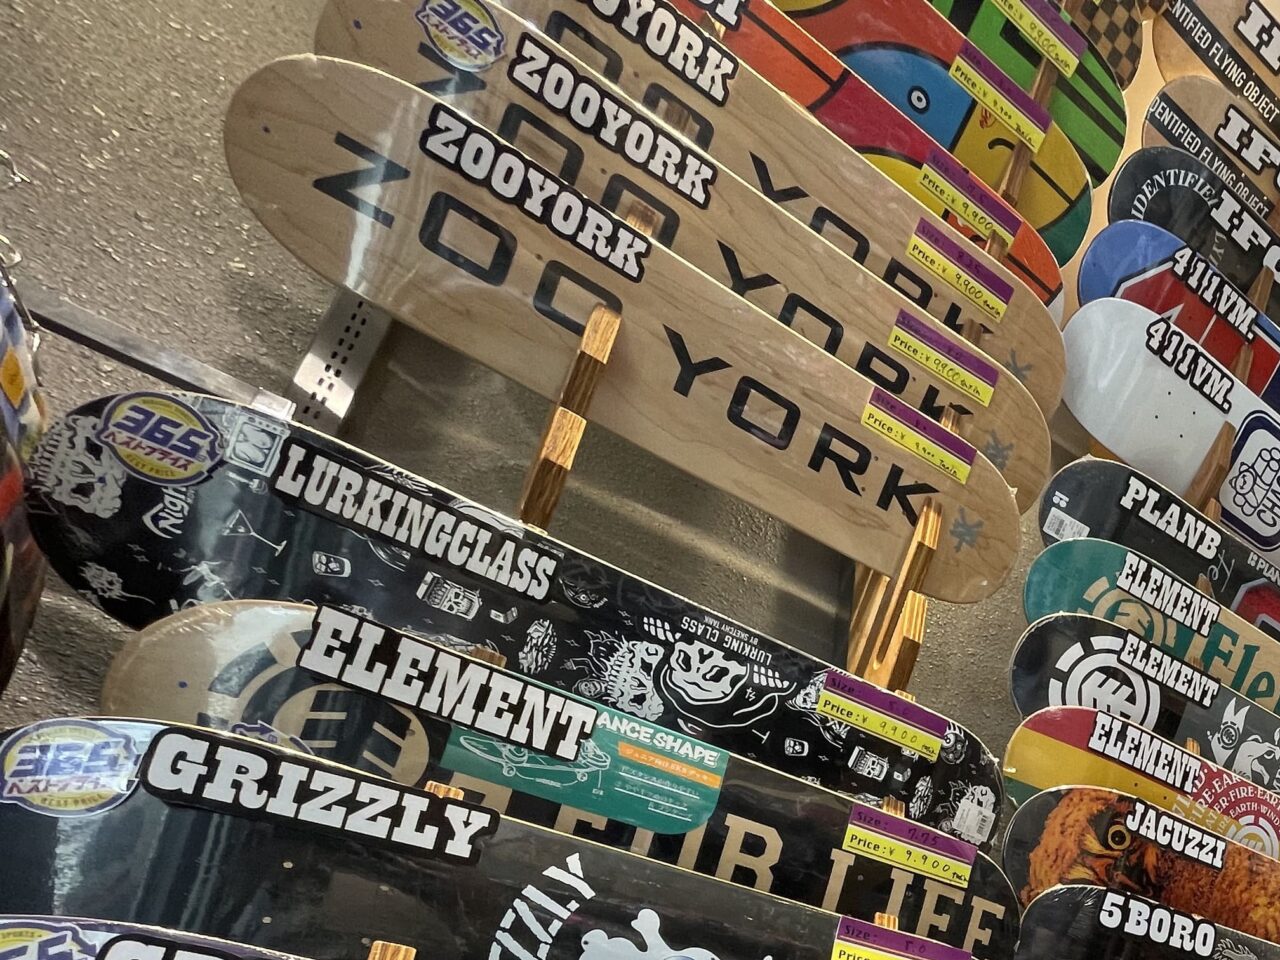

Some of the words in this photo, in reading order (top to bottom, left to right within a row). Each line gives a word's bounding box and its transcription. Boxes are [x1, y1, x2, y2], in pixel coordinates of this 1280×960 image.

[590, 0, 735, 103] YORK
[1208, 41, 1247, 88] FLYING
[1242, 80, 1280, 123] OBJECT
[512, 37, 713, 205] ZOOYORK
[425, 111, 648, 279] ZOOYORK
[663, 323, 940, 528] YORK
[276, 445, 552, 601] LURKINGCLASS
[1119, 475, 1225, 560] PLANB
[681, 615, 720, 643] CLASS
[1116, 551, 1221, 637] ELEMENT
[300, 605, 598, 761] ELEMENT
[722, 639, 773, 666] LURKING
[1118, 633, 1221, 708] ELEMENT
[595, 711, 655, 745] ANCE
[653, 732, 720, 769] SHAPE
[1087, 711, 1202, 793] ELEMENT
[147, 733, 490, 858] GRIZZLY
[1125, 803, 1227, 870] JACUZZI
[1229, 801, 1258, 818] EARTH
[1260, 805, 1280, 827] WIND
